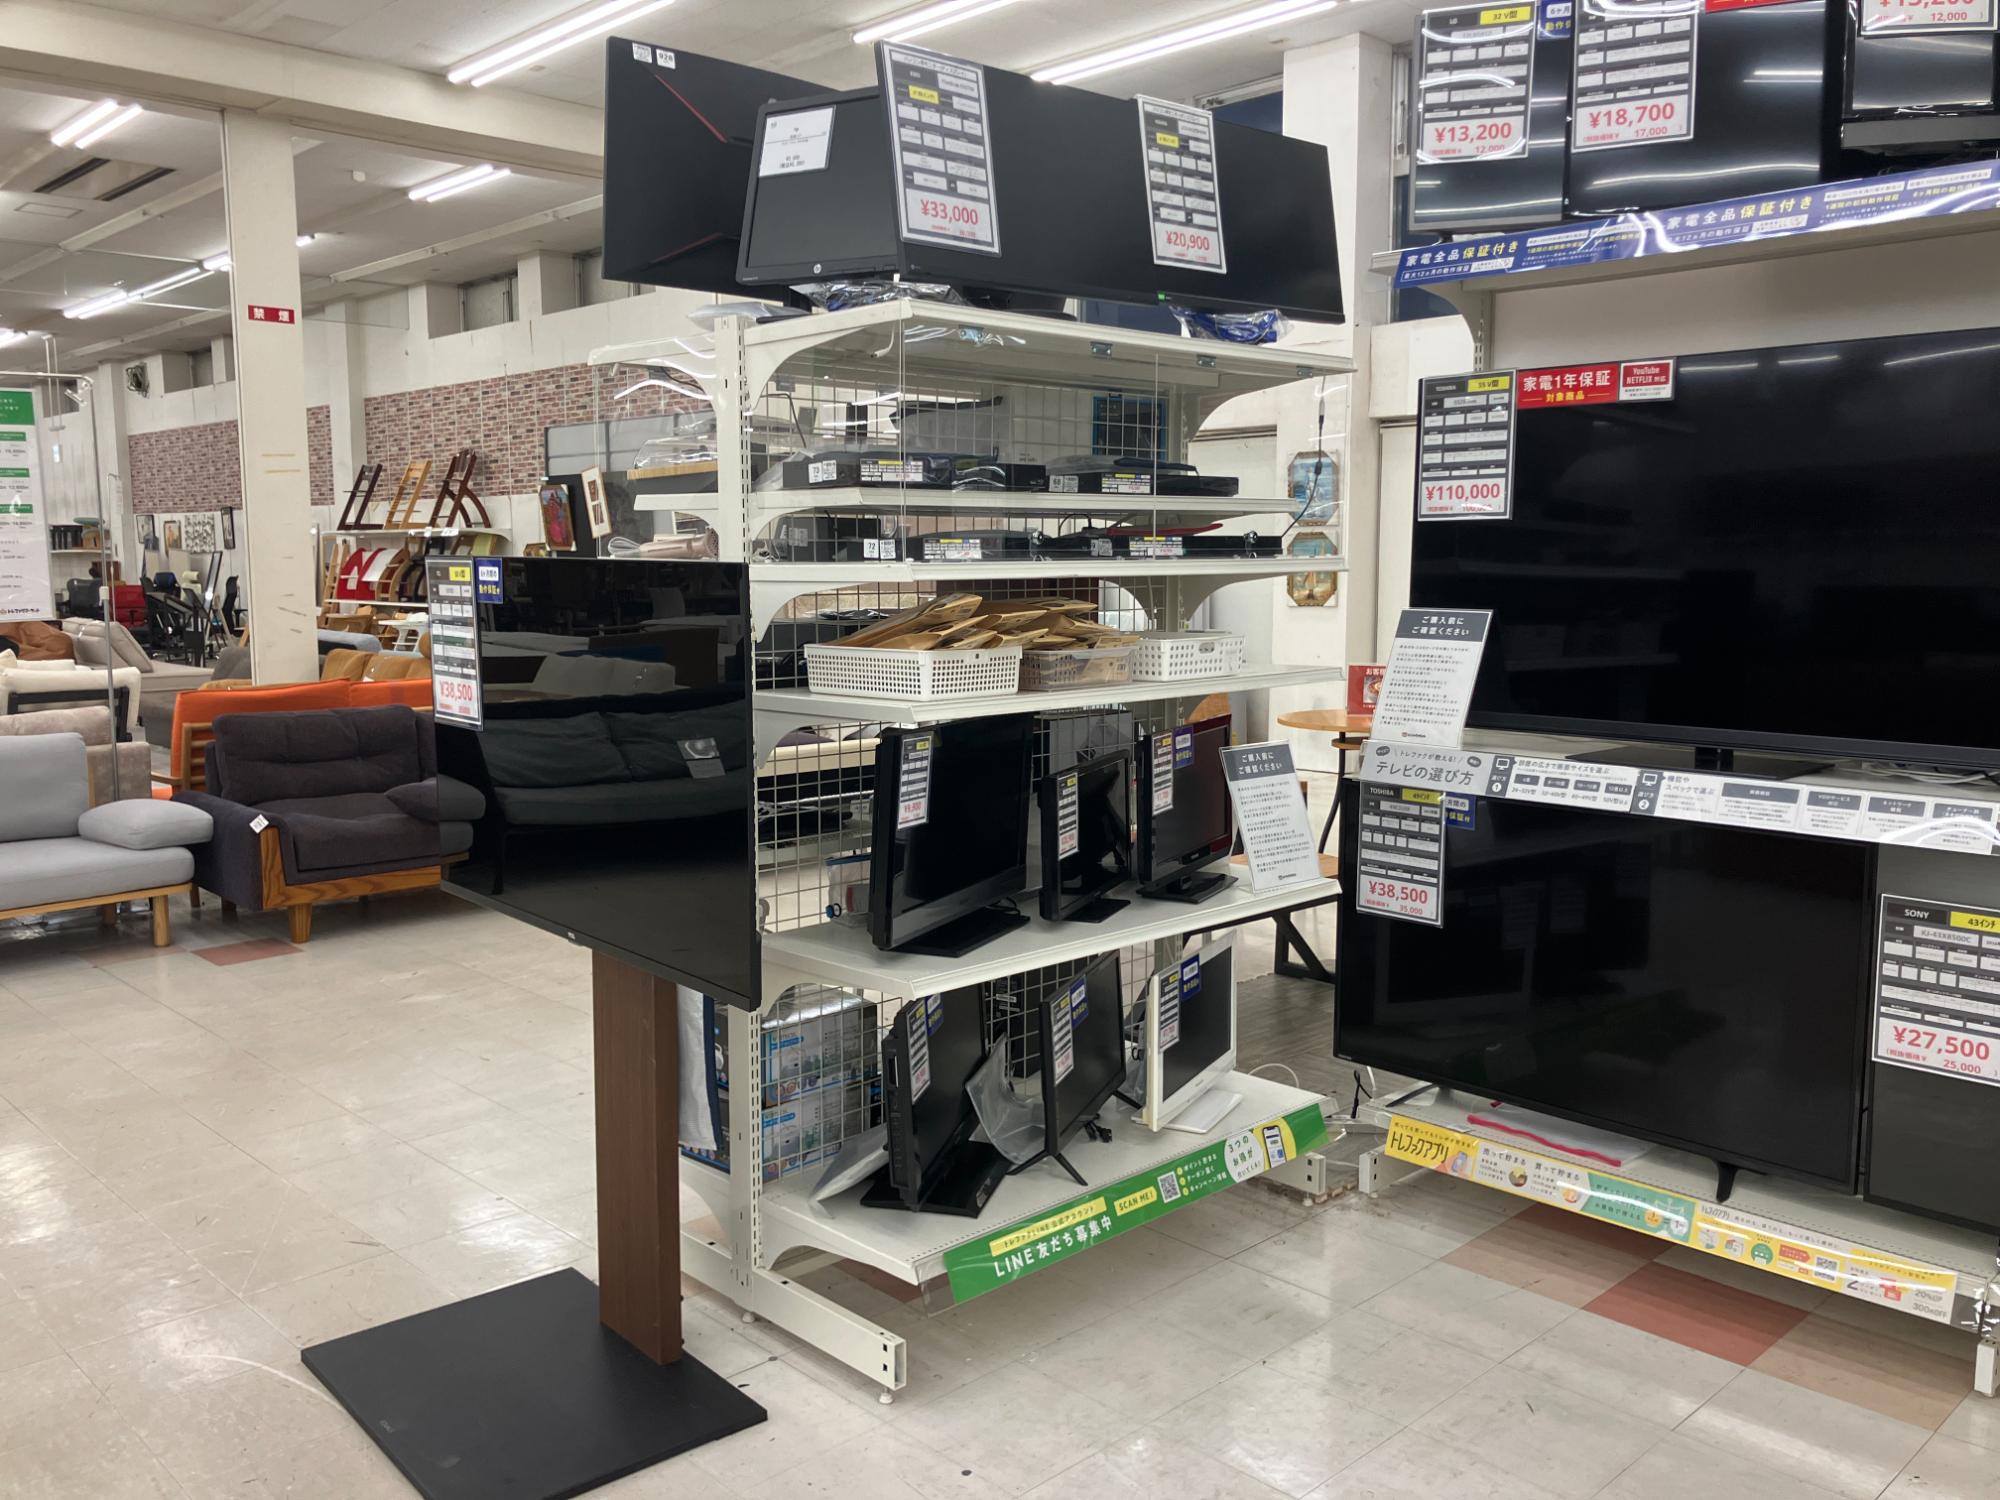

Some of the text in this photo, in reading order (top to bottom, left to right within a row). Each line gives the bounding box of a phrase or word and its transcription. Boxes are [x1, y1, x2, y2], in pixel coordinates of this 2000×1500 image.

[1931, 12, 1968, 22] 12,000
[1589, 102, 1675, 129] ¥18,700
[1434, 122, 1512, 144] ¥13,200
[1634, 126, 1668, 138] 17,000
[920, 199, 979, 226] ¥33,000
[1666, 196, 1813, 231] 家電全品保証付き
[1166, 230, 1210, 251] ¥20,900
[1406, 240, 1519, 267] 家電全品保証付き
[253, 307, 290, 322] 禁煙
[1523, 369, 1612, 393] 家電1年保証
[1626, 376, 1652, 385] NETFLIX
[1633, 366, 1660, 377] YouTube
[1546, 390, 1585, 403] 対象商品
[1426, 483, 1500, 501] ¥110,000
[1421, 616, 1464, 626] ご購入前に
[1411, 626, 1470, 636] ご確認ください
[440, 681, 473, 701] ¥38,500
[1375, 760, 1475, 787] テレビの選び方
[1370, 787, 1394, 796] TOSHIBA
[1665, 783, 1715, 797] スペックで選ぶ
[1368, 880, 1428, 904] ¥38,500
[1400, 903, 1423, 915] 35,000
[1904, 908, 1930, 920] SONY
[1967, 917, 1996, 929] 43インチ
[1893, 1025, 1990, 1061] ¥27,500
[1943, 1059, 1981, 1074] 25,000
[1390, 1130, 1450, 1164] トレファクアプリ
[1534, 1161, 1580, 1182] 買って貯まる
[1119, 1191, 1154, 1211] SCAN ME!
[993, 1214, 1112, 1277] LINE 友だち募集中
